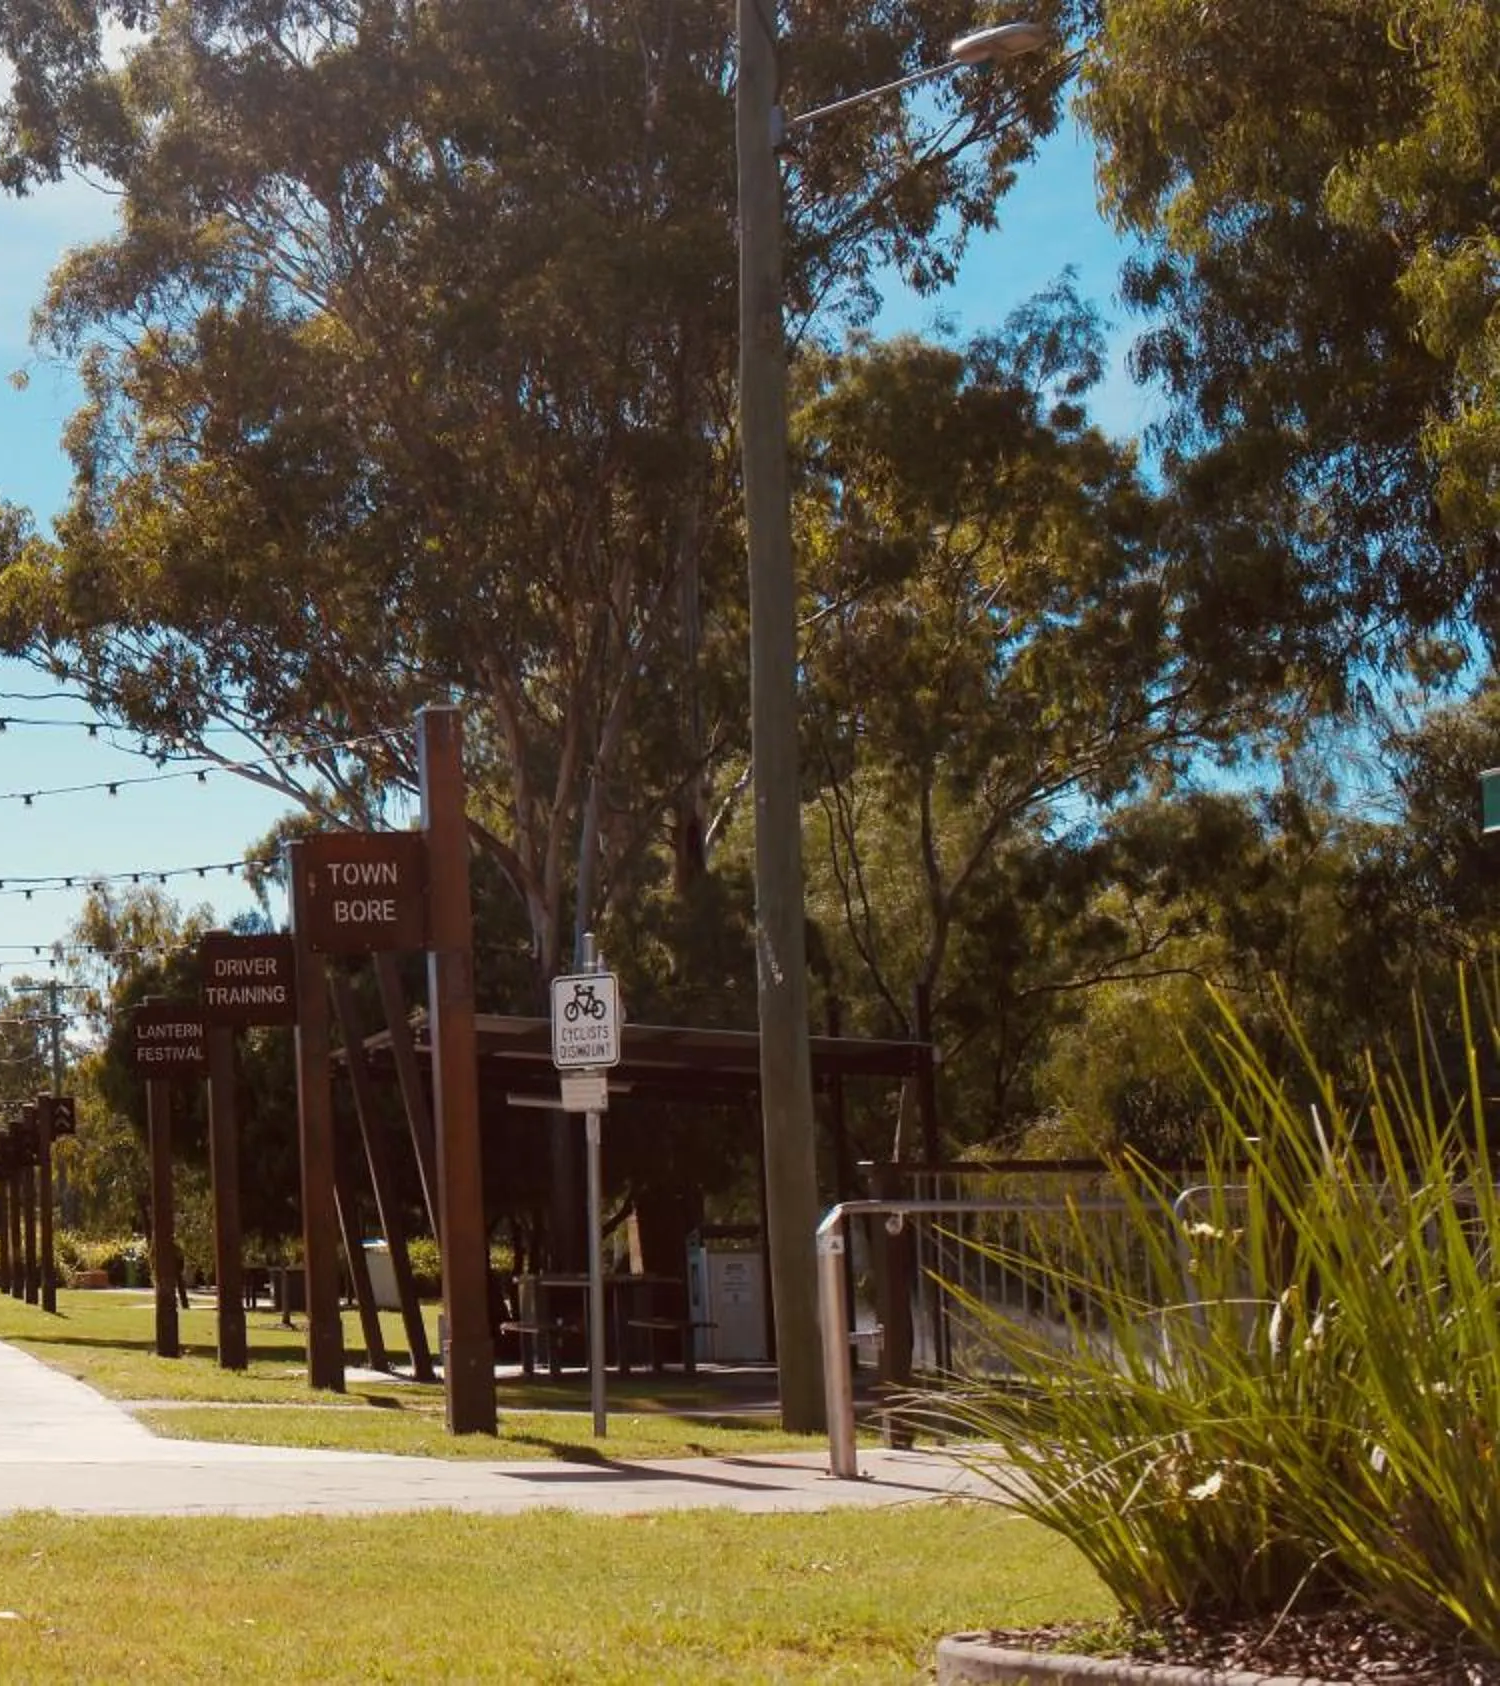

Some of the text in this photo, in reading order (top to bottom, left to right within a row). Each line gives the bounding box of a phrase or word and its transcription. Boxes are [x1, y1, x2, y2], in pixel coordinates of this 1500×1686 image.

[327, 863, 398, 885] TOWN
[334, 899, 397, 923] BORE
[215, 957, 277, 976] DRIVER
[206, 985, 286, 1005] TRAINING
[137, 1023, 203, 1039] LANTERN
[562, 1026, 608, 1041] CYCLISTS
[137, 1046, 204, 1061] FESTIVAL
[560, 1043, 610, 1058] DISMOUNT
